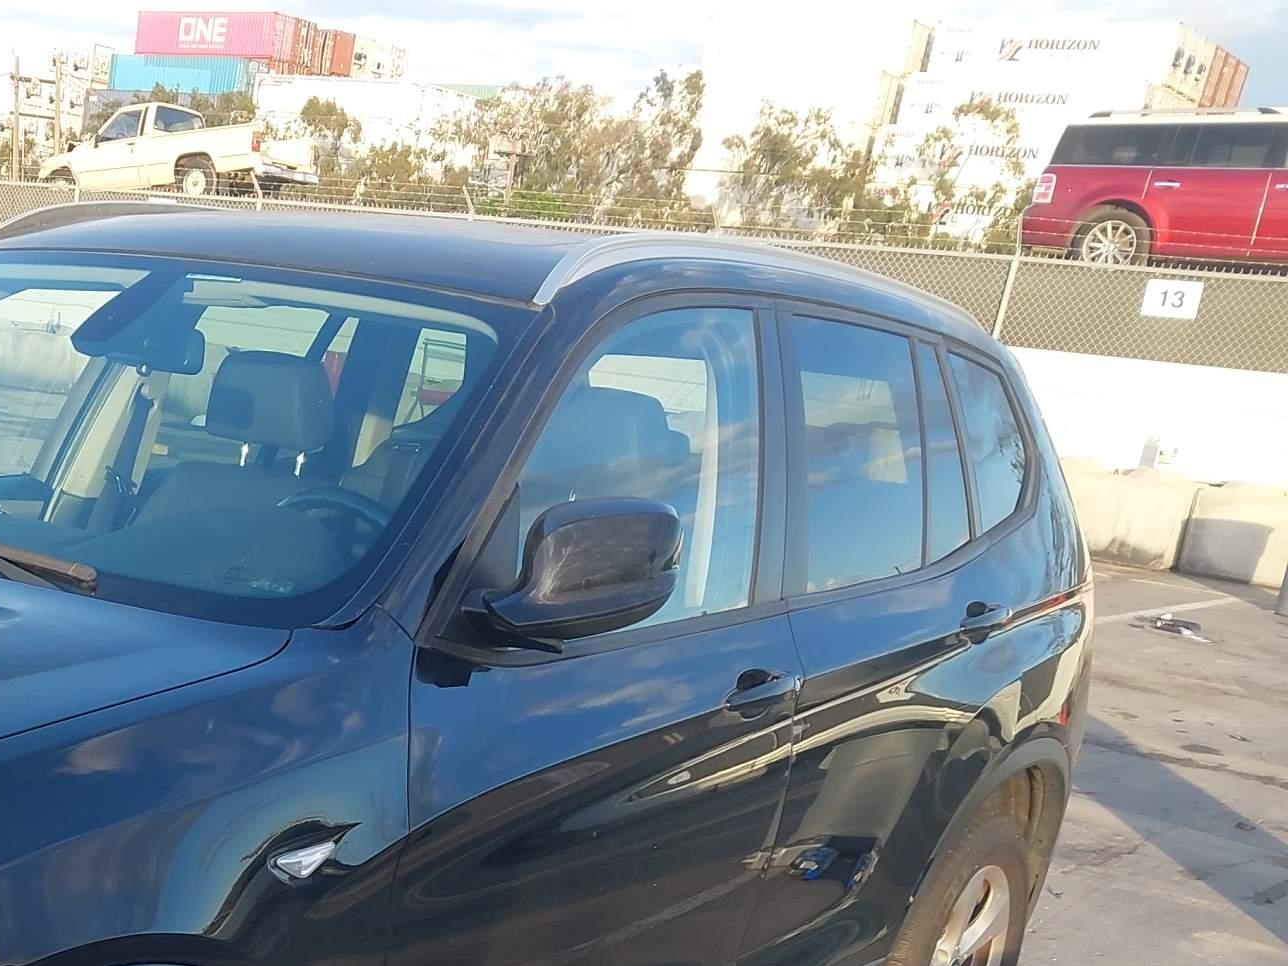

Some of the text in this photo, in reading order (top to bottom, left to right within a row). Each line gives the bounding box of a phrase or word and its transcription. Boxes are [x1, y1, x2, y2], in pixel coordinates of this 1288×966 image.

[179, 16, 229, 42] ONE
[1027, 38, 1101, 51] HORIZON
[996, 91, 1070, 105] HORIZON
[968, 144, 1040, 159] HORIZON
[954, 202, 1016, 219] HORIZO
[1160, 289, 1185, 309] 13
